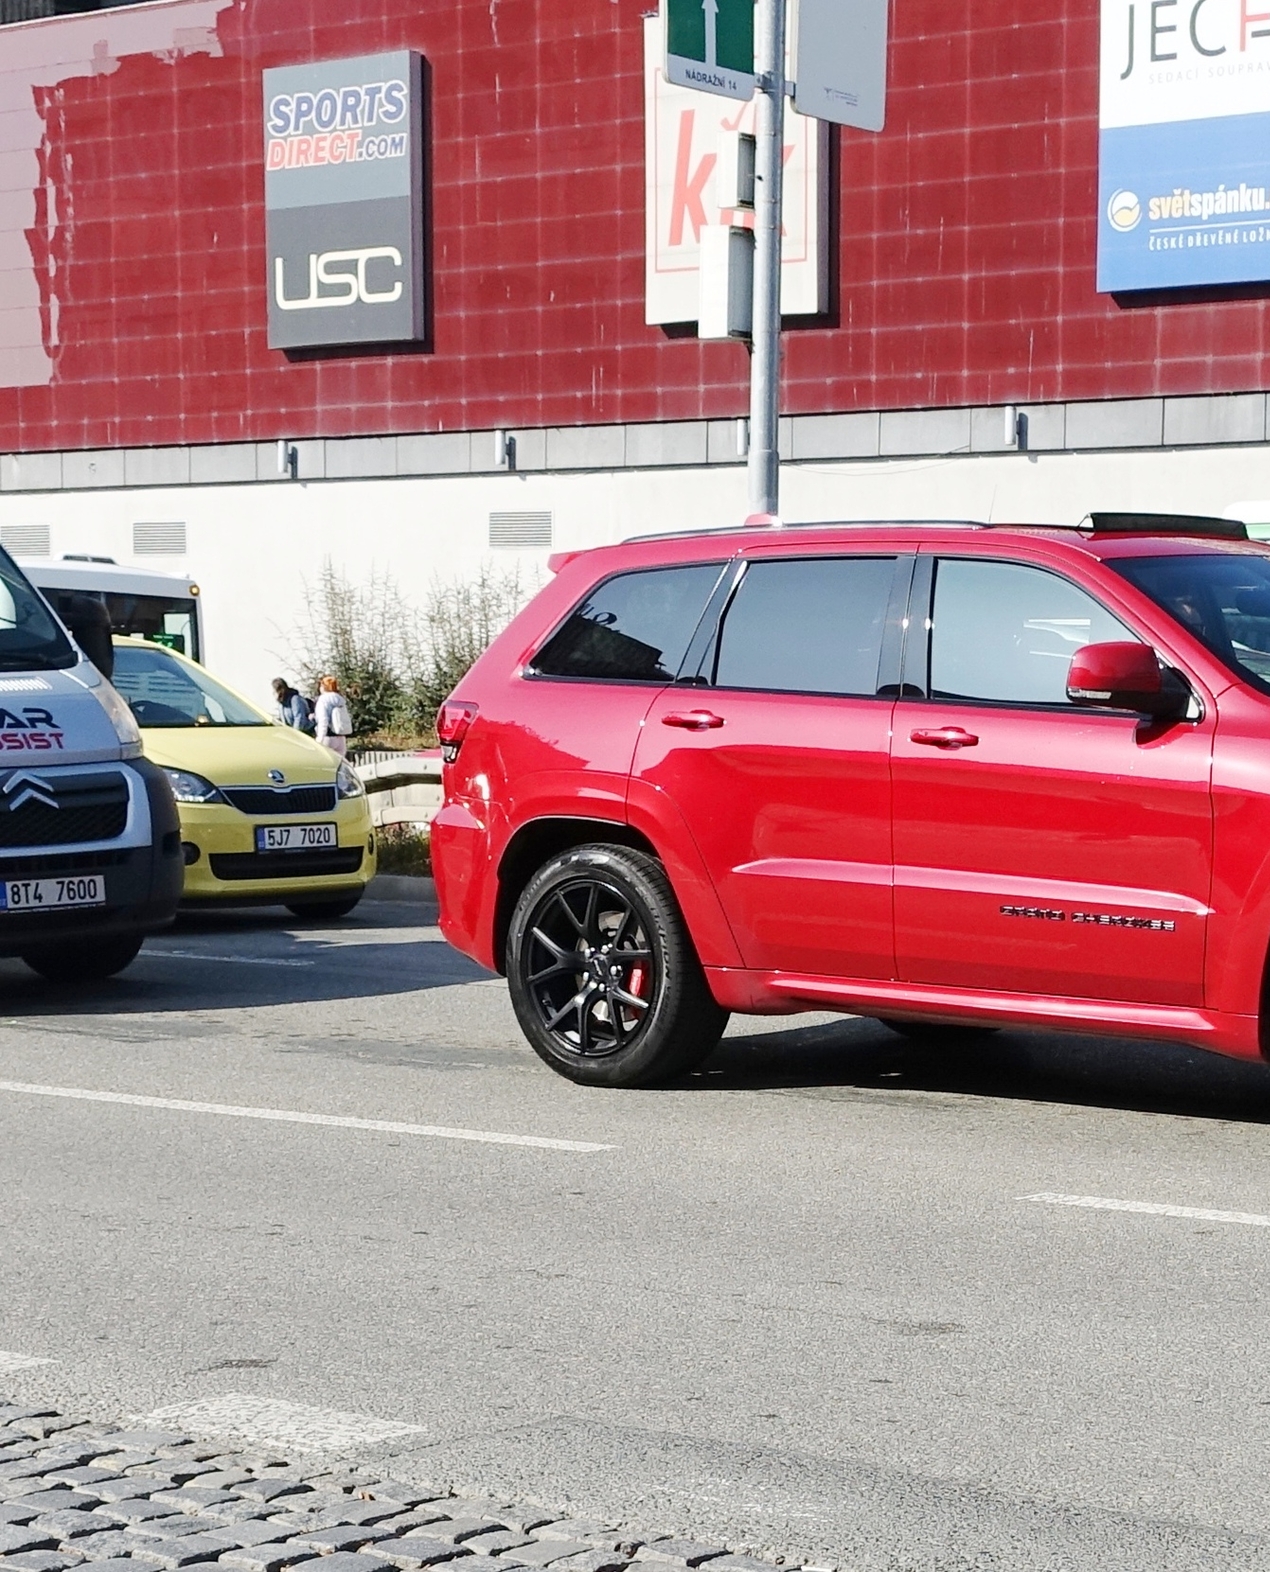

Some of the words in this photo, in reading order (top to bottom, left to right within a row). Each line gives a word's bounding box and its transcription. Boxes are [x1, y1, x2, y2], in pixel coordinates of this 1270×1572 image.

[685, 69, 725, 89] NÁDRAŽNÍ
[729, 80, 737, 90] 14
[1149, 67, 1200, 84] SEDACÍ
[267, 80, 408, 136] SPORTS
[266, 130, 407, 171] DIRECT.COM
[1149, 233, 1185, 251] ČESKÉ
[275, 246, 402, 310] USC
[267, 829, 291, 846] 5J7
[300, 827, 331, 845] 7020
[11, 882, 43, 905] 8T4
[56, 879, 97, 902] 7600
